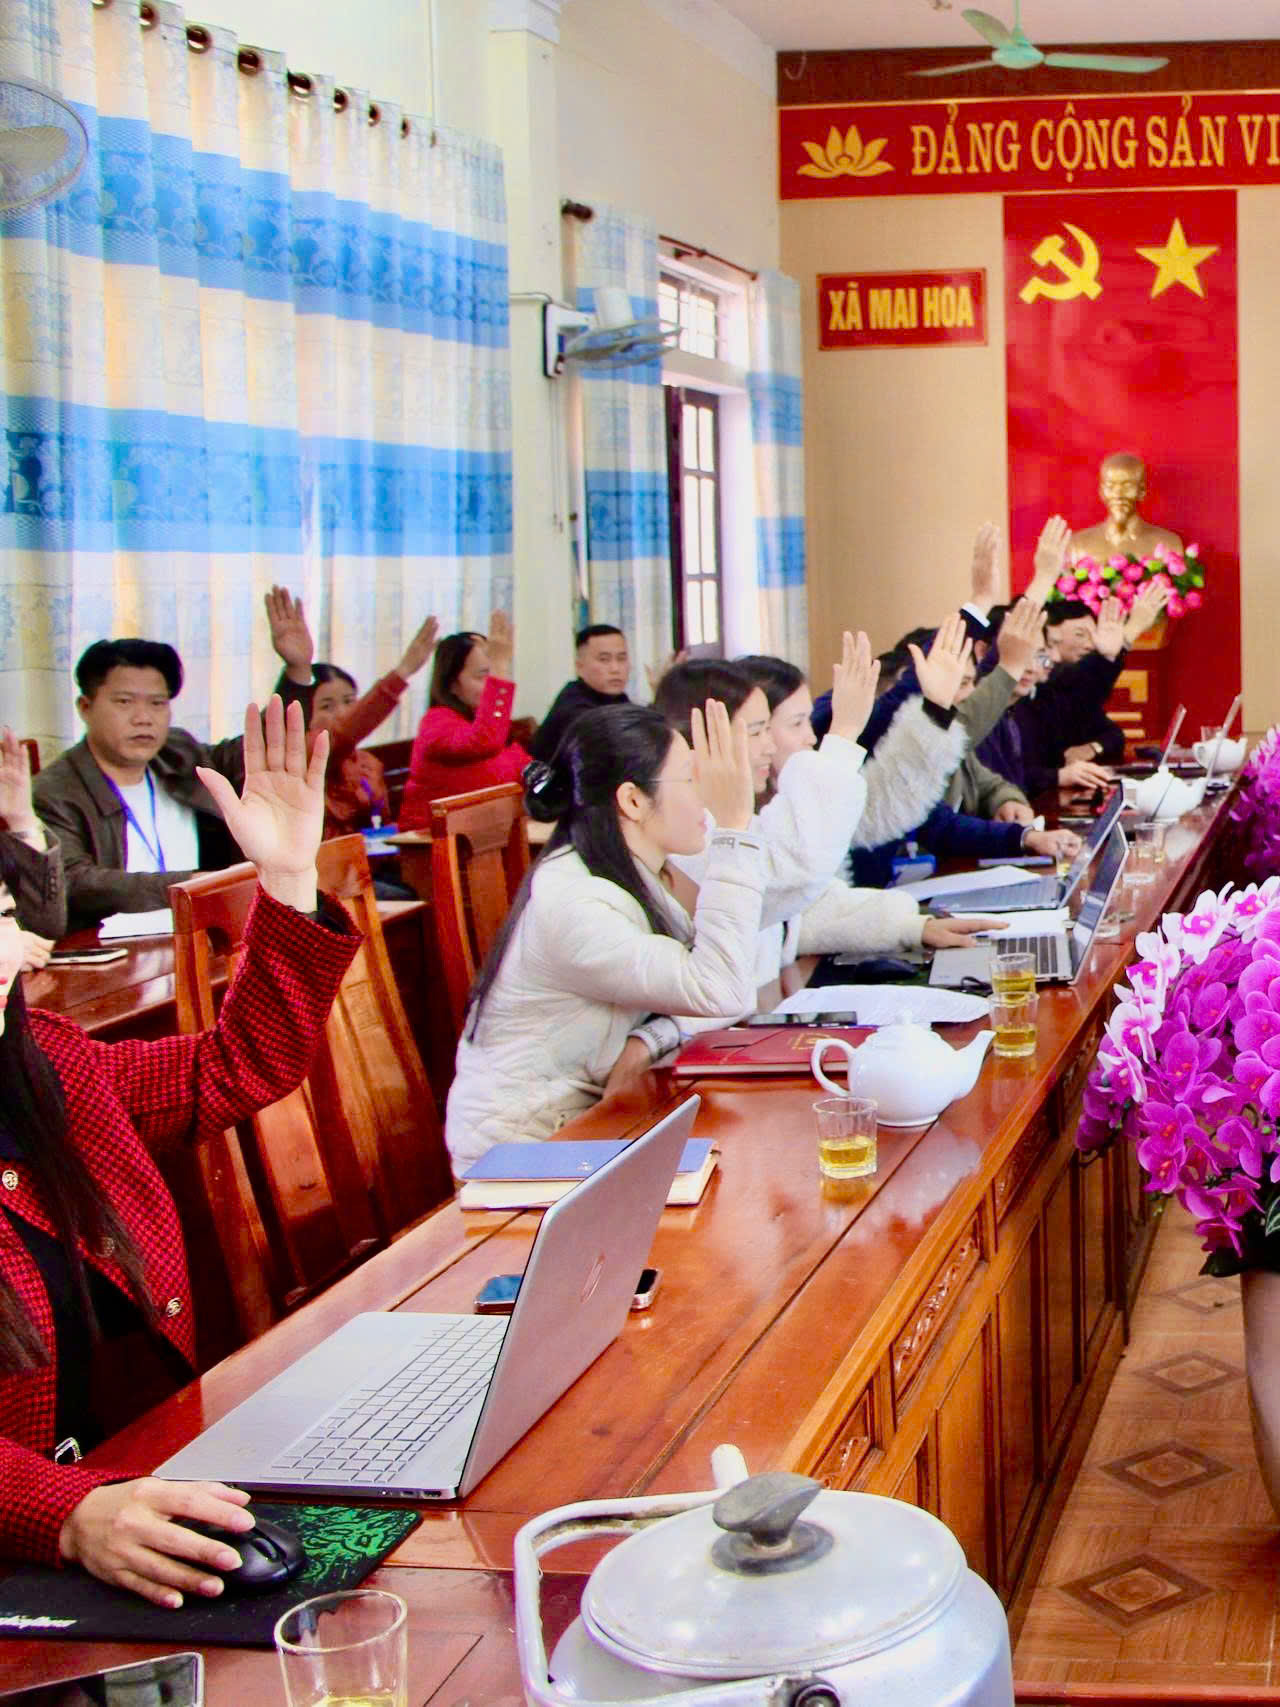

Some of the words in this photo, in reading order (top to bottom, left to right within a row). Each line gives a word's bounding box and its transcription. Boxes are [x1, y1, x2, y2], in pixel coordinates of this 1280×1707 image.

[911, 104, 1021, 175] ĐẢNG
[1031, 103, 1138, 182] CỘNG
[1146, 96, 1227, 168] SẢN
[829, 281, 864, 331] XÃ
[869, 288, 918, 330] MAI
[923, 285, 975, 328] HOA
